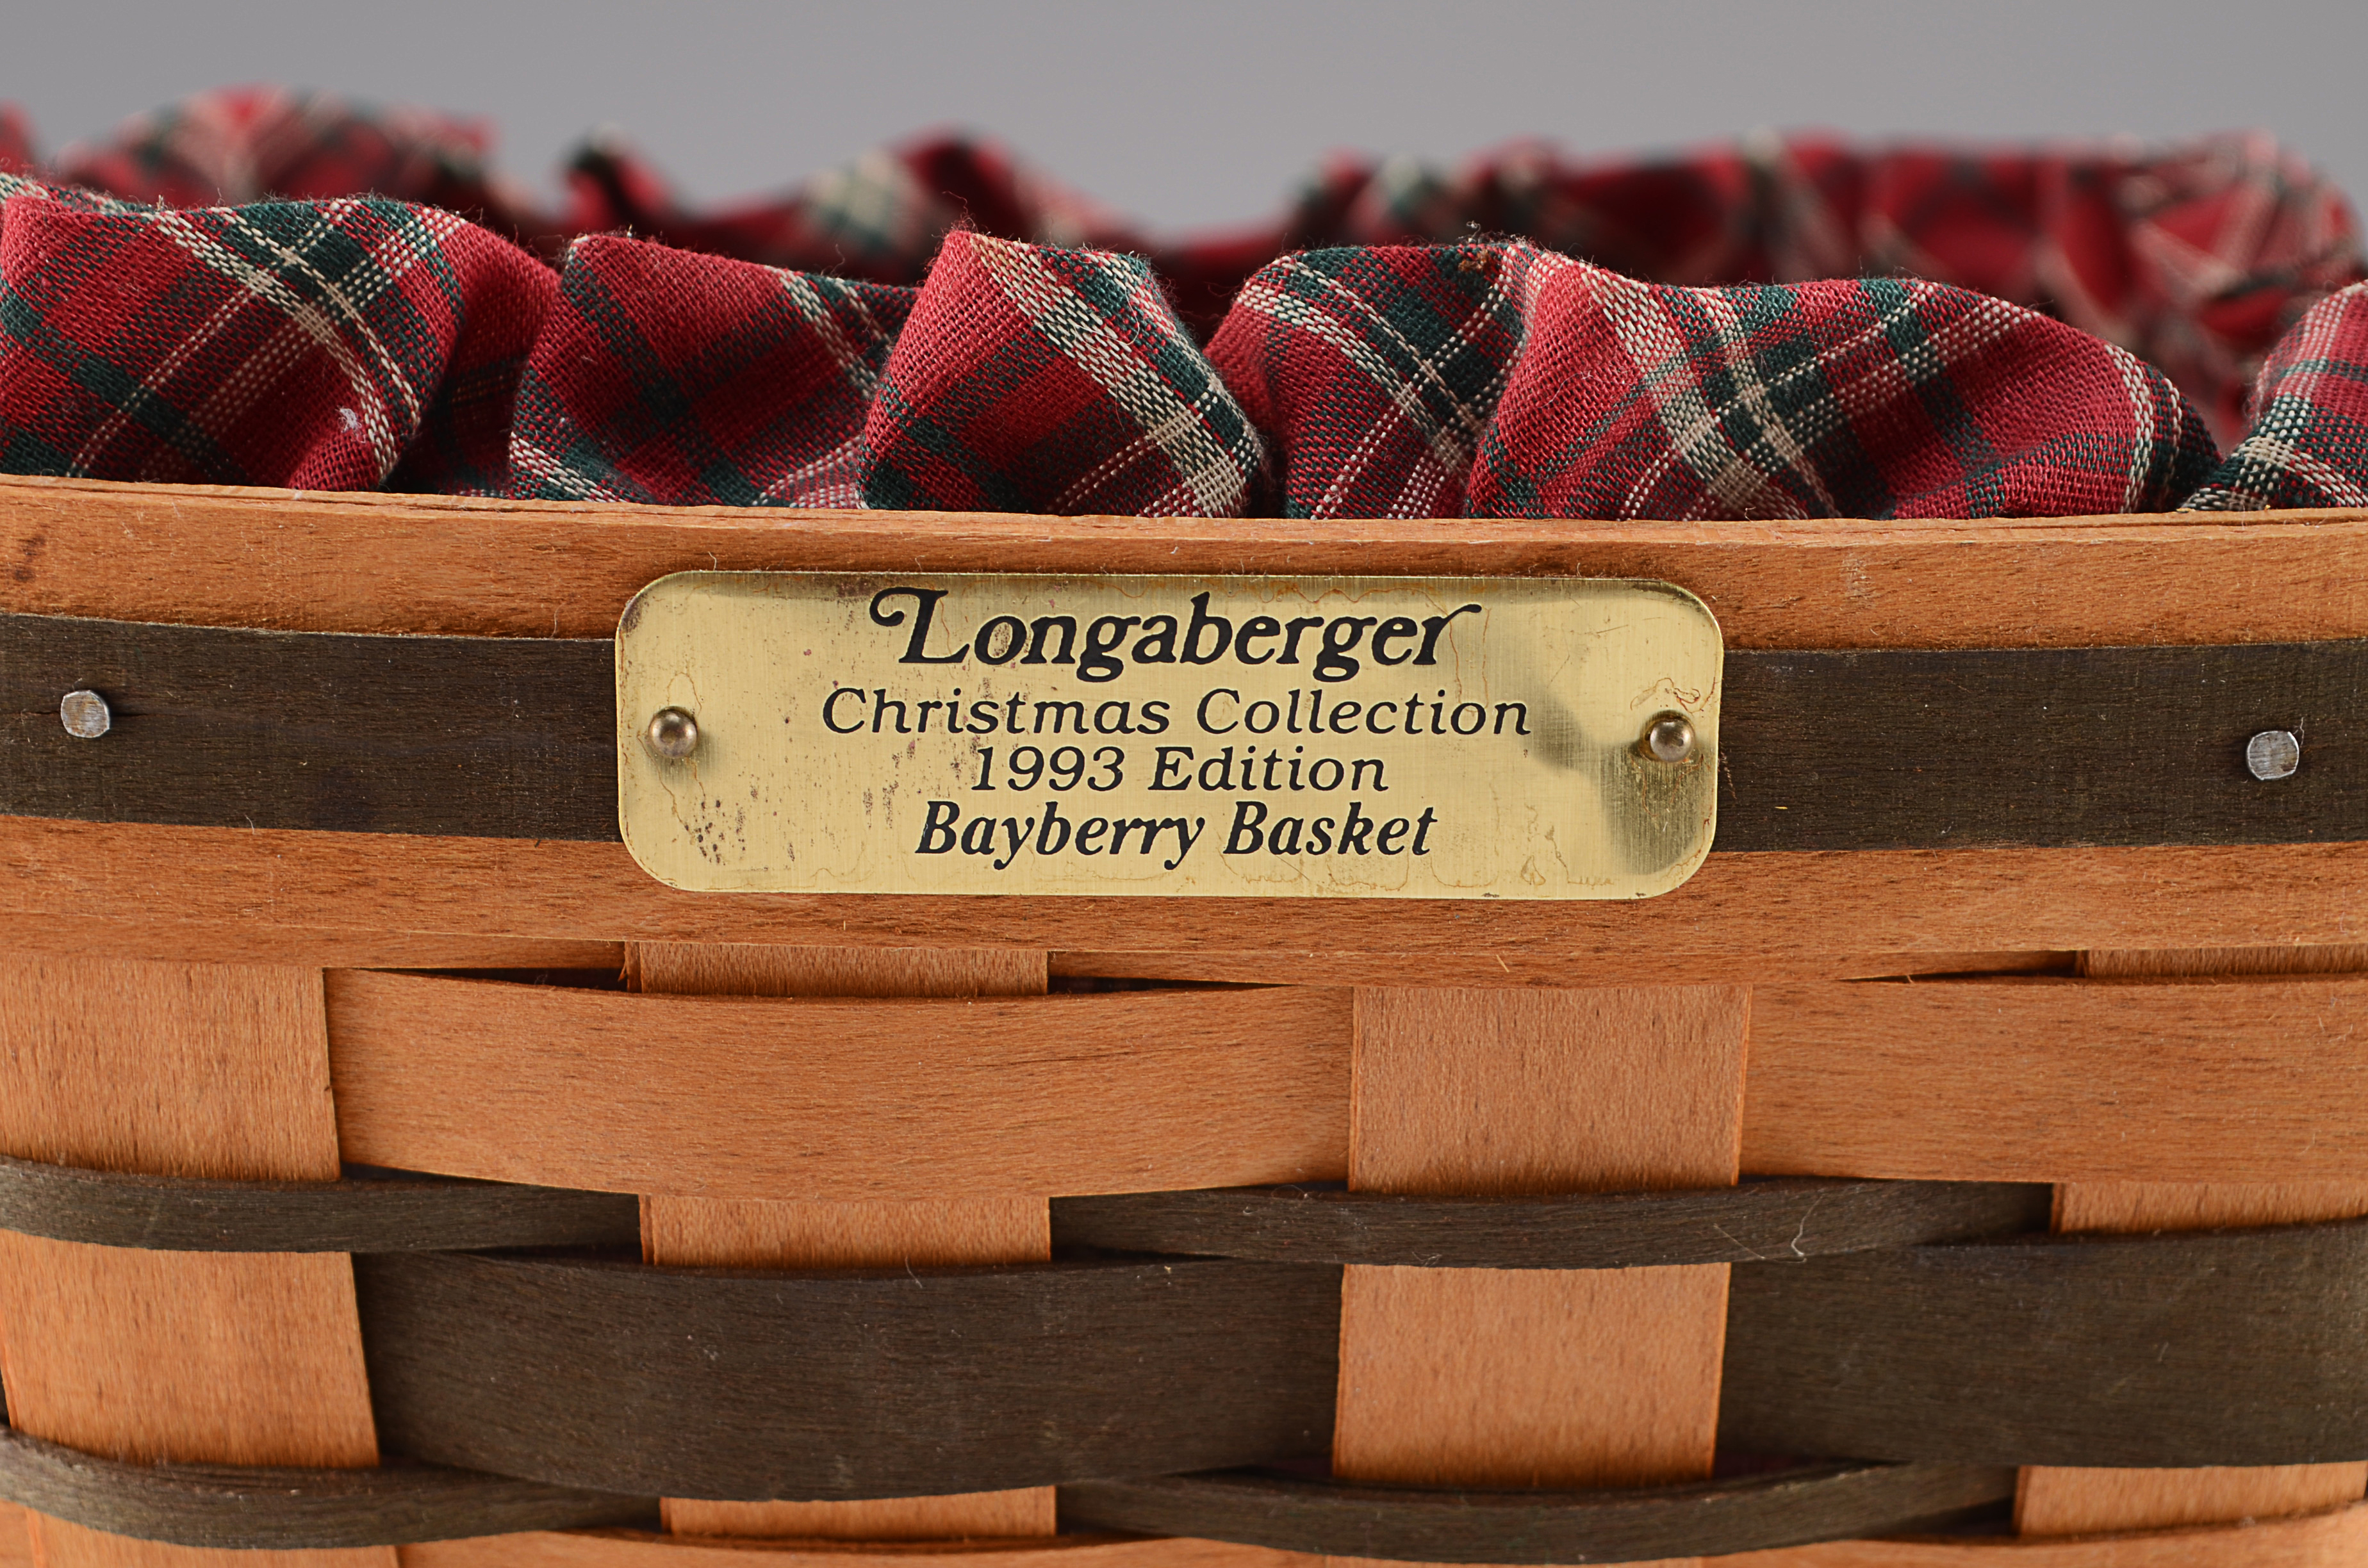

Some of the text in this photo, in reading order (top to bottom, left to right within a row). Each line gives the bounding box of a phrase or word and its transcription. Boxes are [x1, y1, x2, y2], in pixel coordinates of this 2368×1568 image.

[869, 587, 1481, 683] Longaberger
[823, 687, 1531, 735] Christmas Collection
[971, 746, 1389, 792] 1993 Edition
[915, 801, 1438, 870] Bayberry Basket
